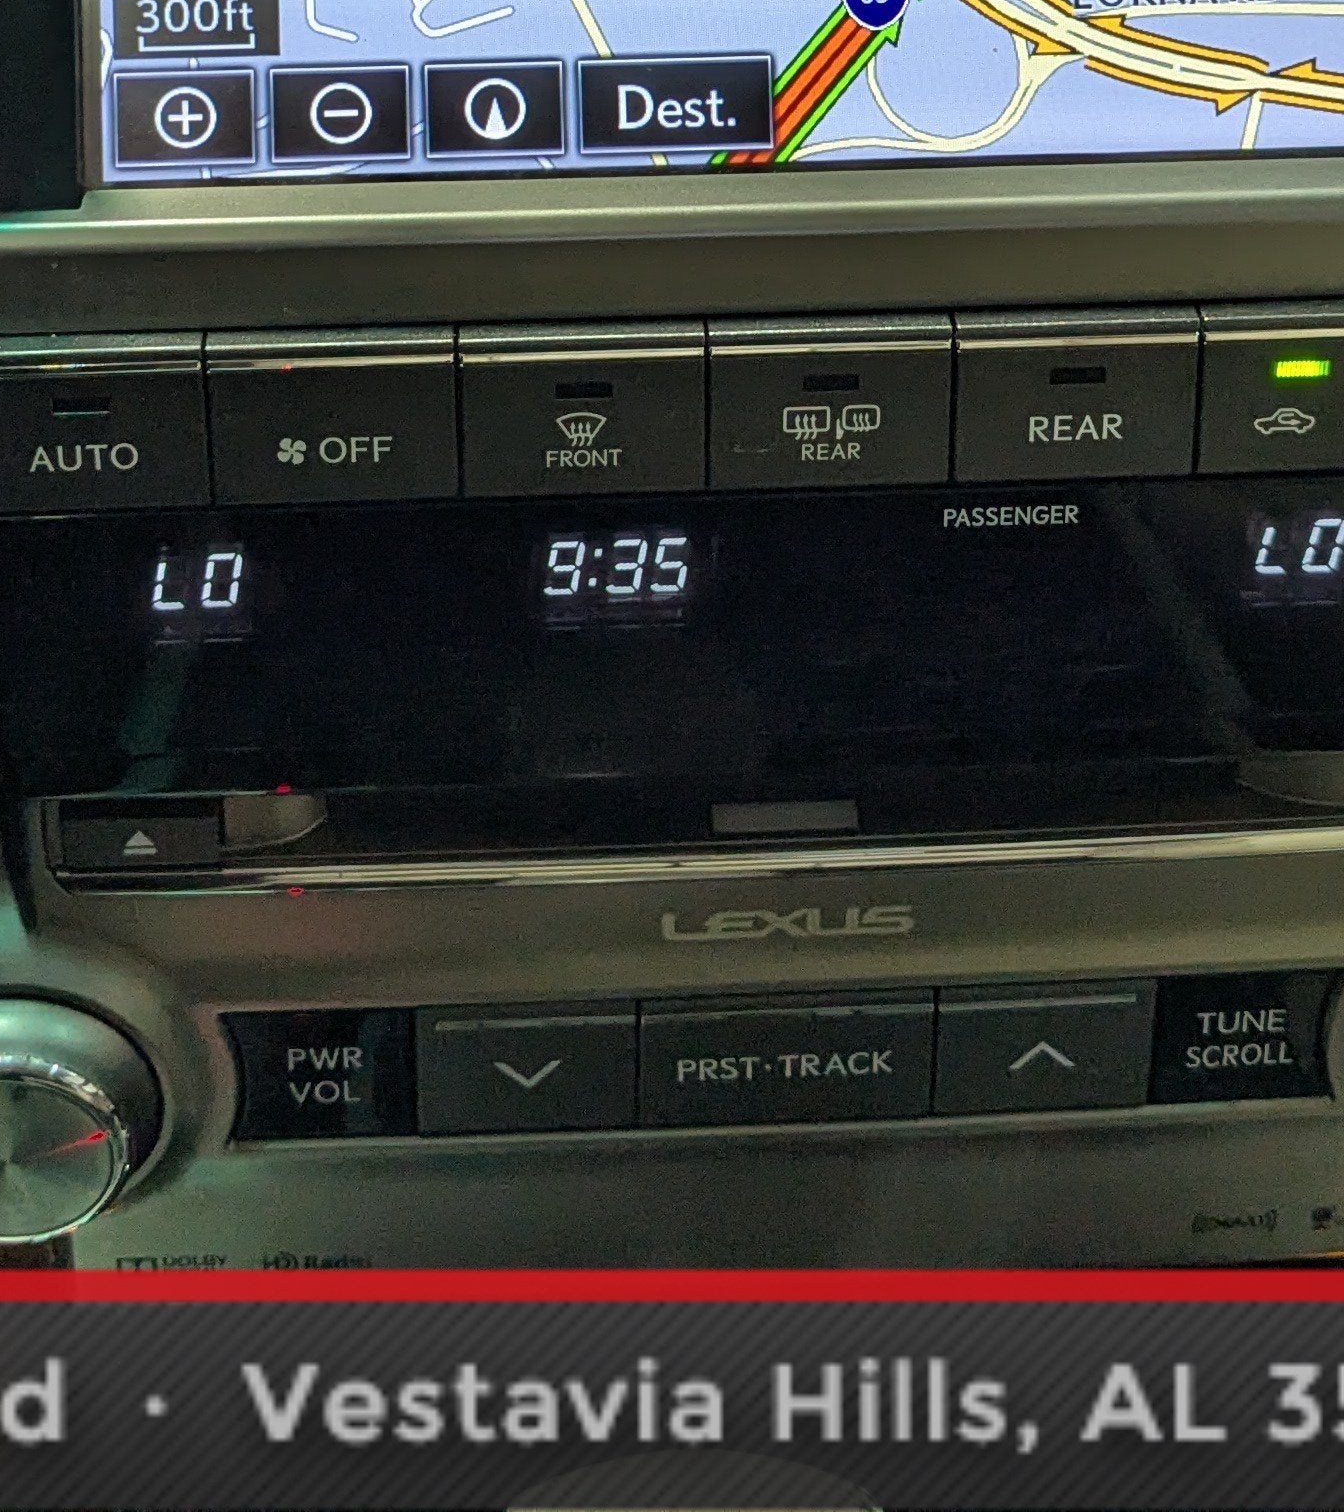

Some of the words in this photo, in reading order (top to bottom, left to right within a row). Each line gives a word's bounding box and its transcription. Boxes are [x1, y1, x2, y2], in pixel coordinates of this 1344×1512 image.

[617, 85, 737, 133] Dest.
[1027, 413, 1124, 445] REAR
[29, 442, 140, 474] AUTO
[318, 435, 394, 464] OFF
[544, 448, 623, 469] FRONT
[800, 442, 861, 462] REAR
[942, 503, 1080, 529] PASSENGER
[543, 536, 688, 595] 9:35
[661, 905, 915, 941] LEXUS
[1197, 1008, 1288, 1035] TUNE
[286, 1046, 364, 1072] PWR
[1184, 1041, 1295, 1070] SCROLL
[288, 1078, 362, 1105] VOL
